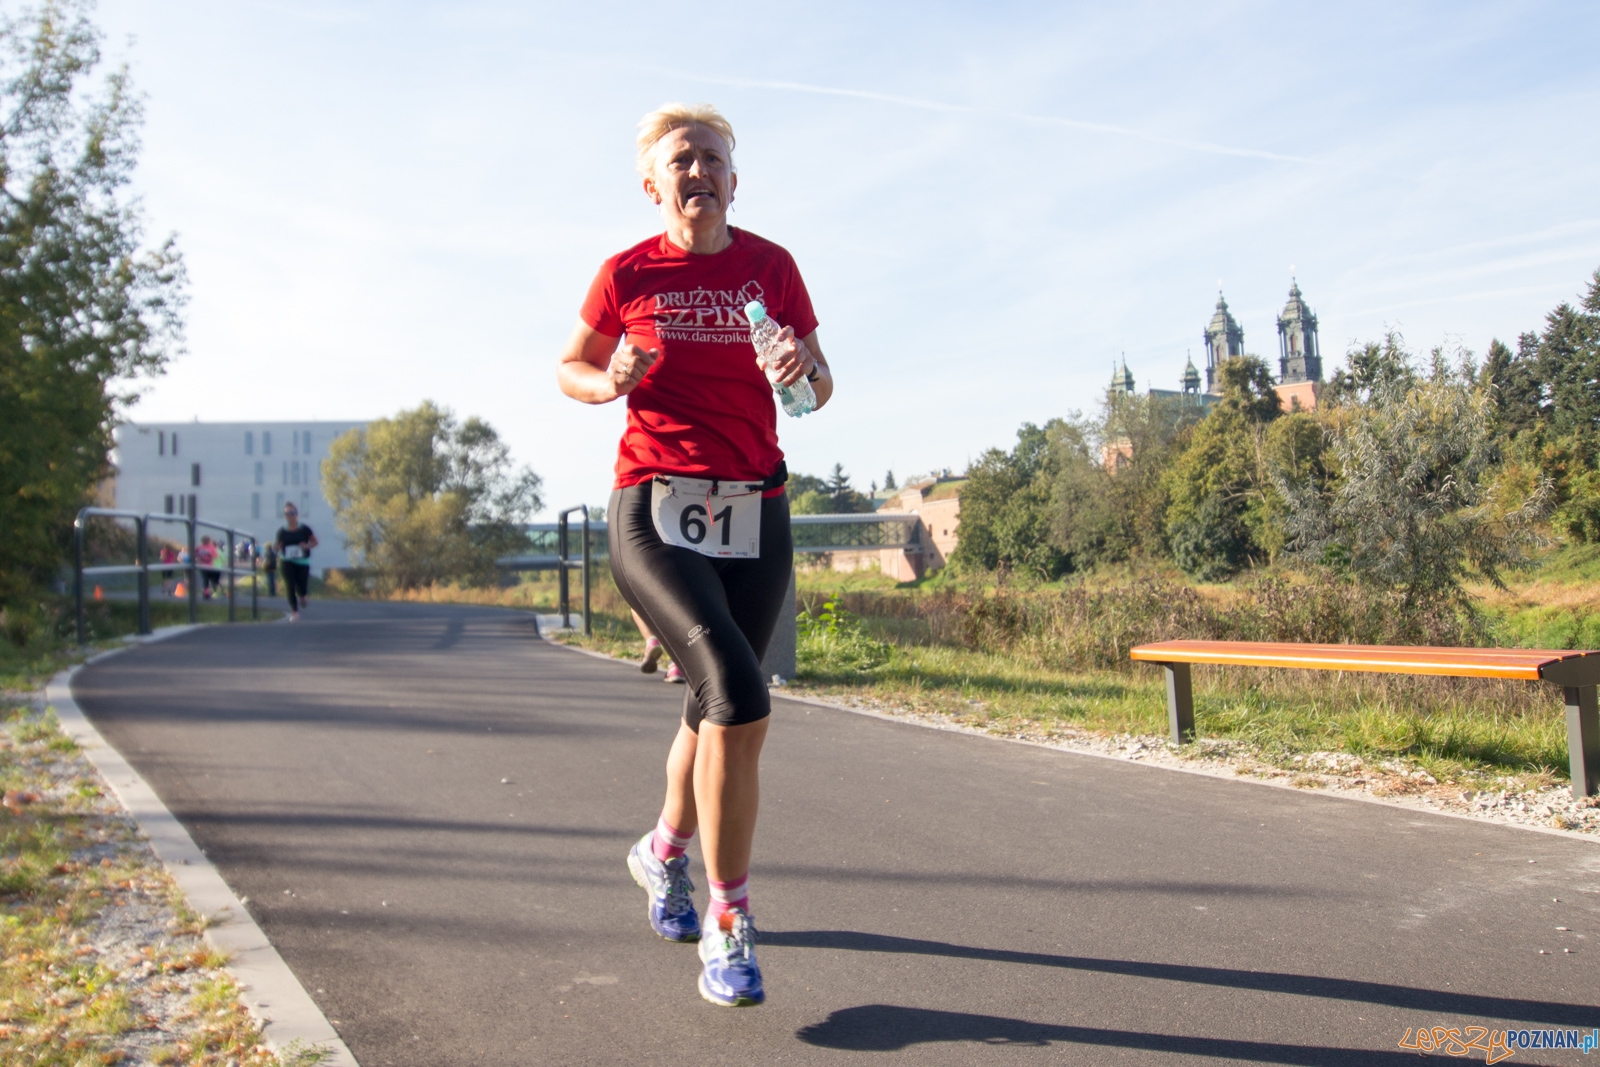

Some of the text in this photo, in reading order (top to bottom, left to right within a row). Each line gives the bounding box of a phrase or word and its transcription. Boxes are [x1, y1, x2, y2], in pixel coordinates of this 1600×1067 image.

[654, 285, 748, 310] DRUŻYNA
[653, 305, 768, 327] SZPIK
[679, 503, 733, 546] 61
